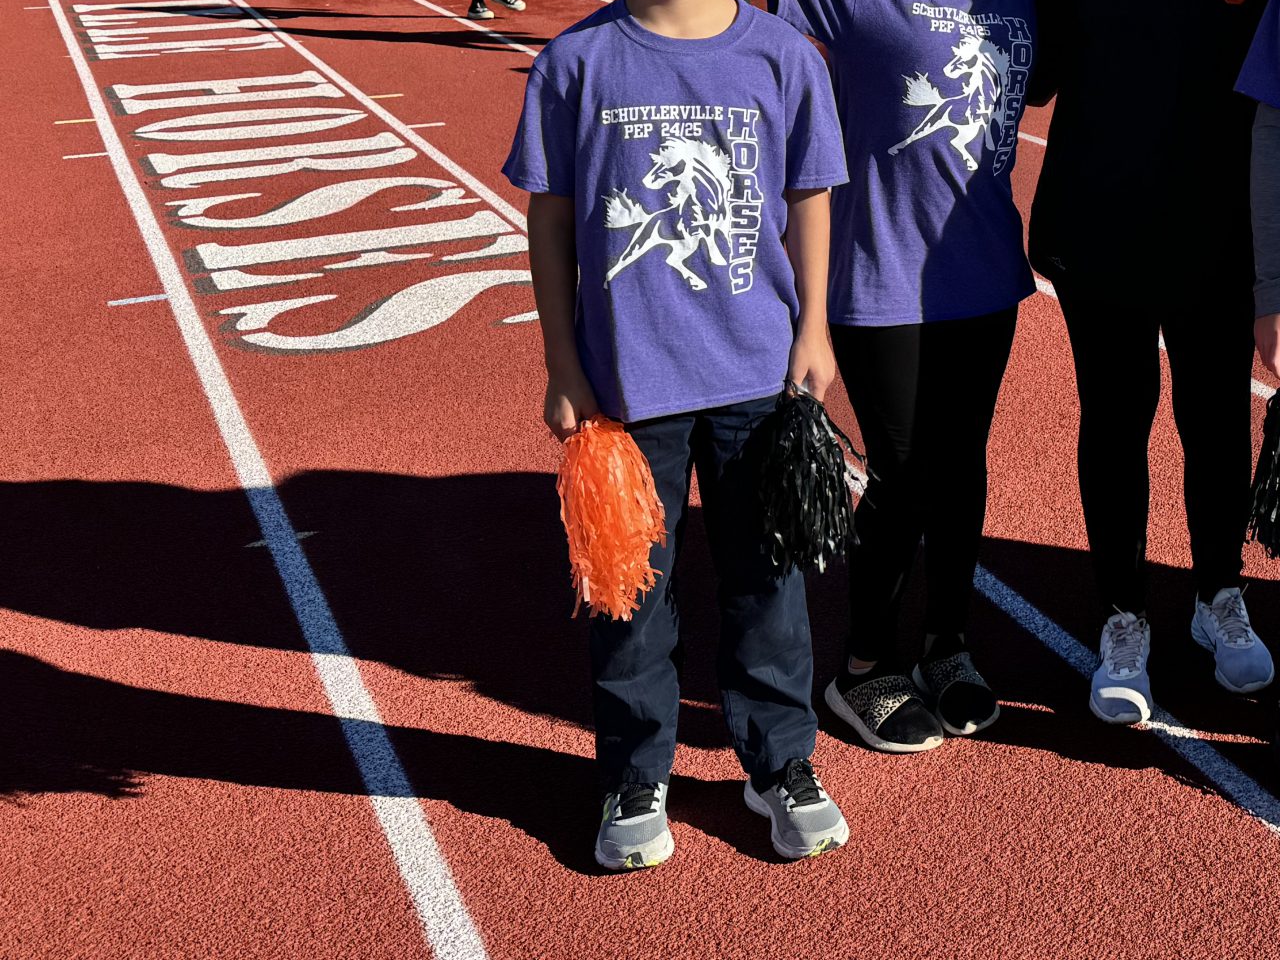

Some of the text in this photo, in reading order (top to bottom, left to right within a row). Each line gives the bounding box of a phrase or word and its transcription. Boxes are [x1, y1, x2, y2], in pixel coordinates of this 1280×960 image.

[930, 19, 991, 36] PEP 24/25
[602, 105, 724, 124] SCHUYLERVILLE
[624, 122, 702, 139] PEP 24/25
[993, 16, 1033, 177] HORSES
[112, 69, 539, 351] HORSES
[727, 107, 764, 295] HORSES
